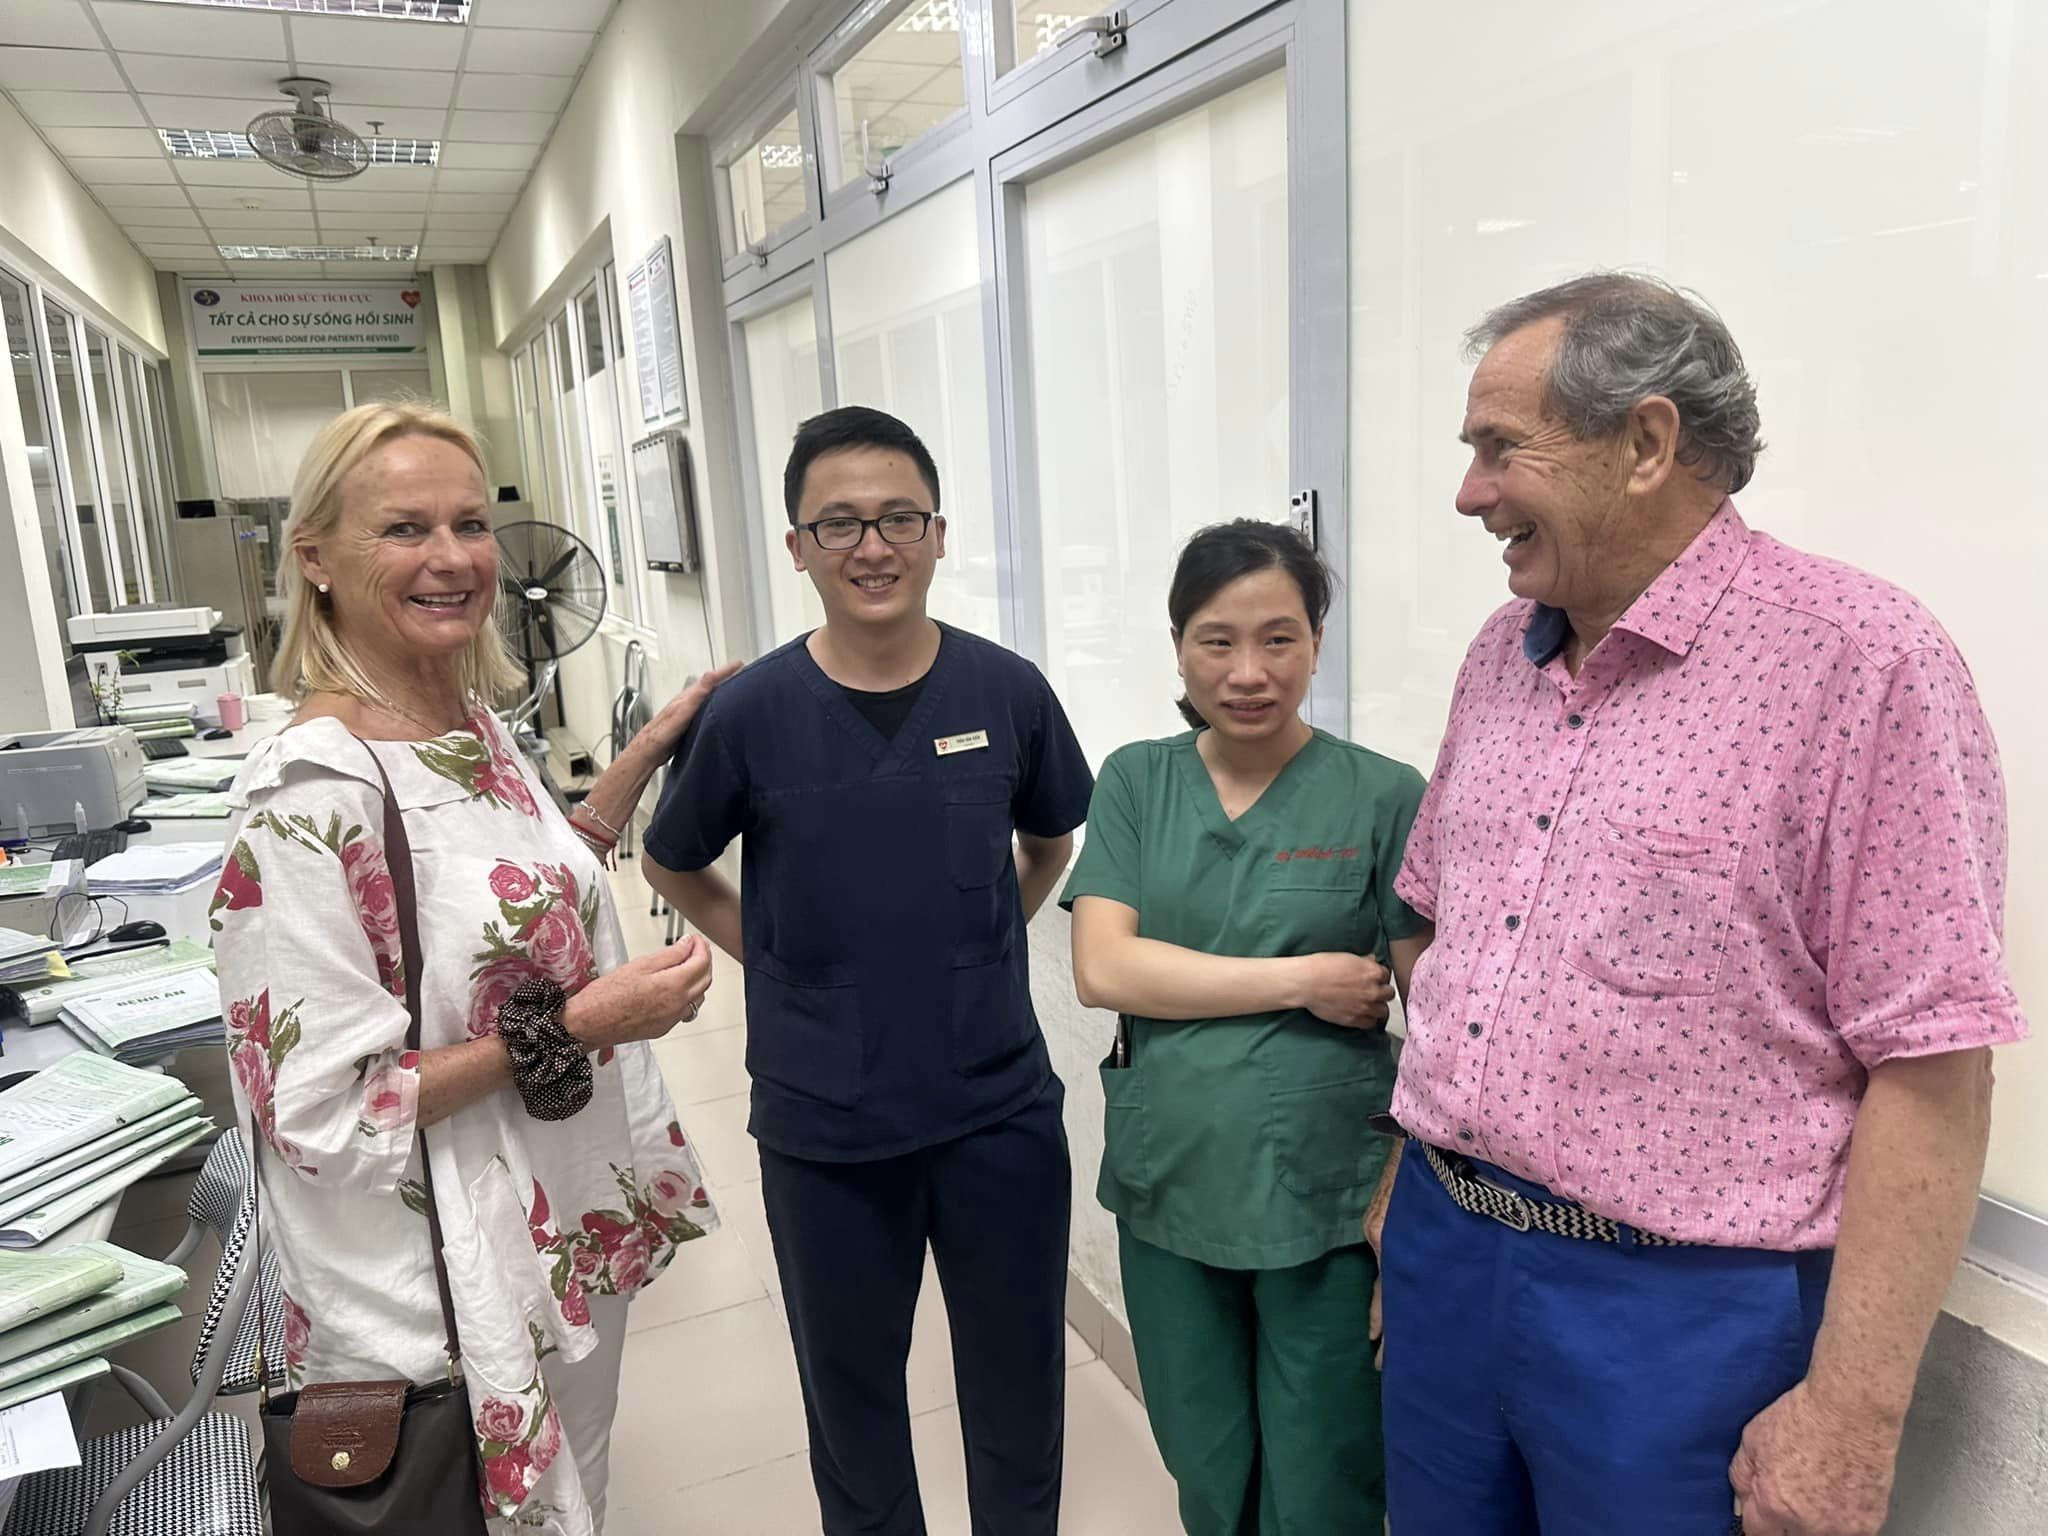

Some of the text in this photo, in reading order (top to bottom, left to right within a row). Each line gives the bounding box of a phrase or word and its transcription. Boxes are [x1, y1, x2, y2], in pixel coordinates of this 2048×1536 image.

[208, 311, 235, 326] TẤT
[236, 310, 256, 326] CẢ
[259, 313, 290, 326] CHO
[292, 311, 313, 329] SỰ
[382, 312, 415, 326] SINH
[231, 333, 400, 344] EVERYTHING DONE FOR PATIENTS REVIVED
